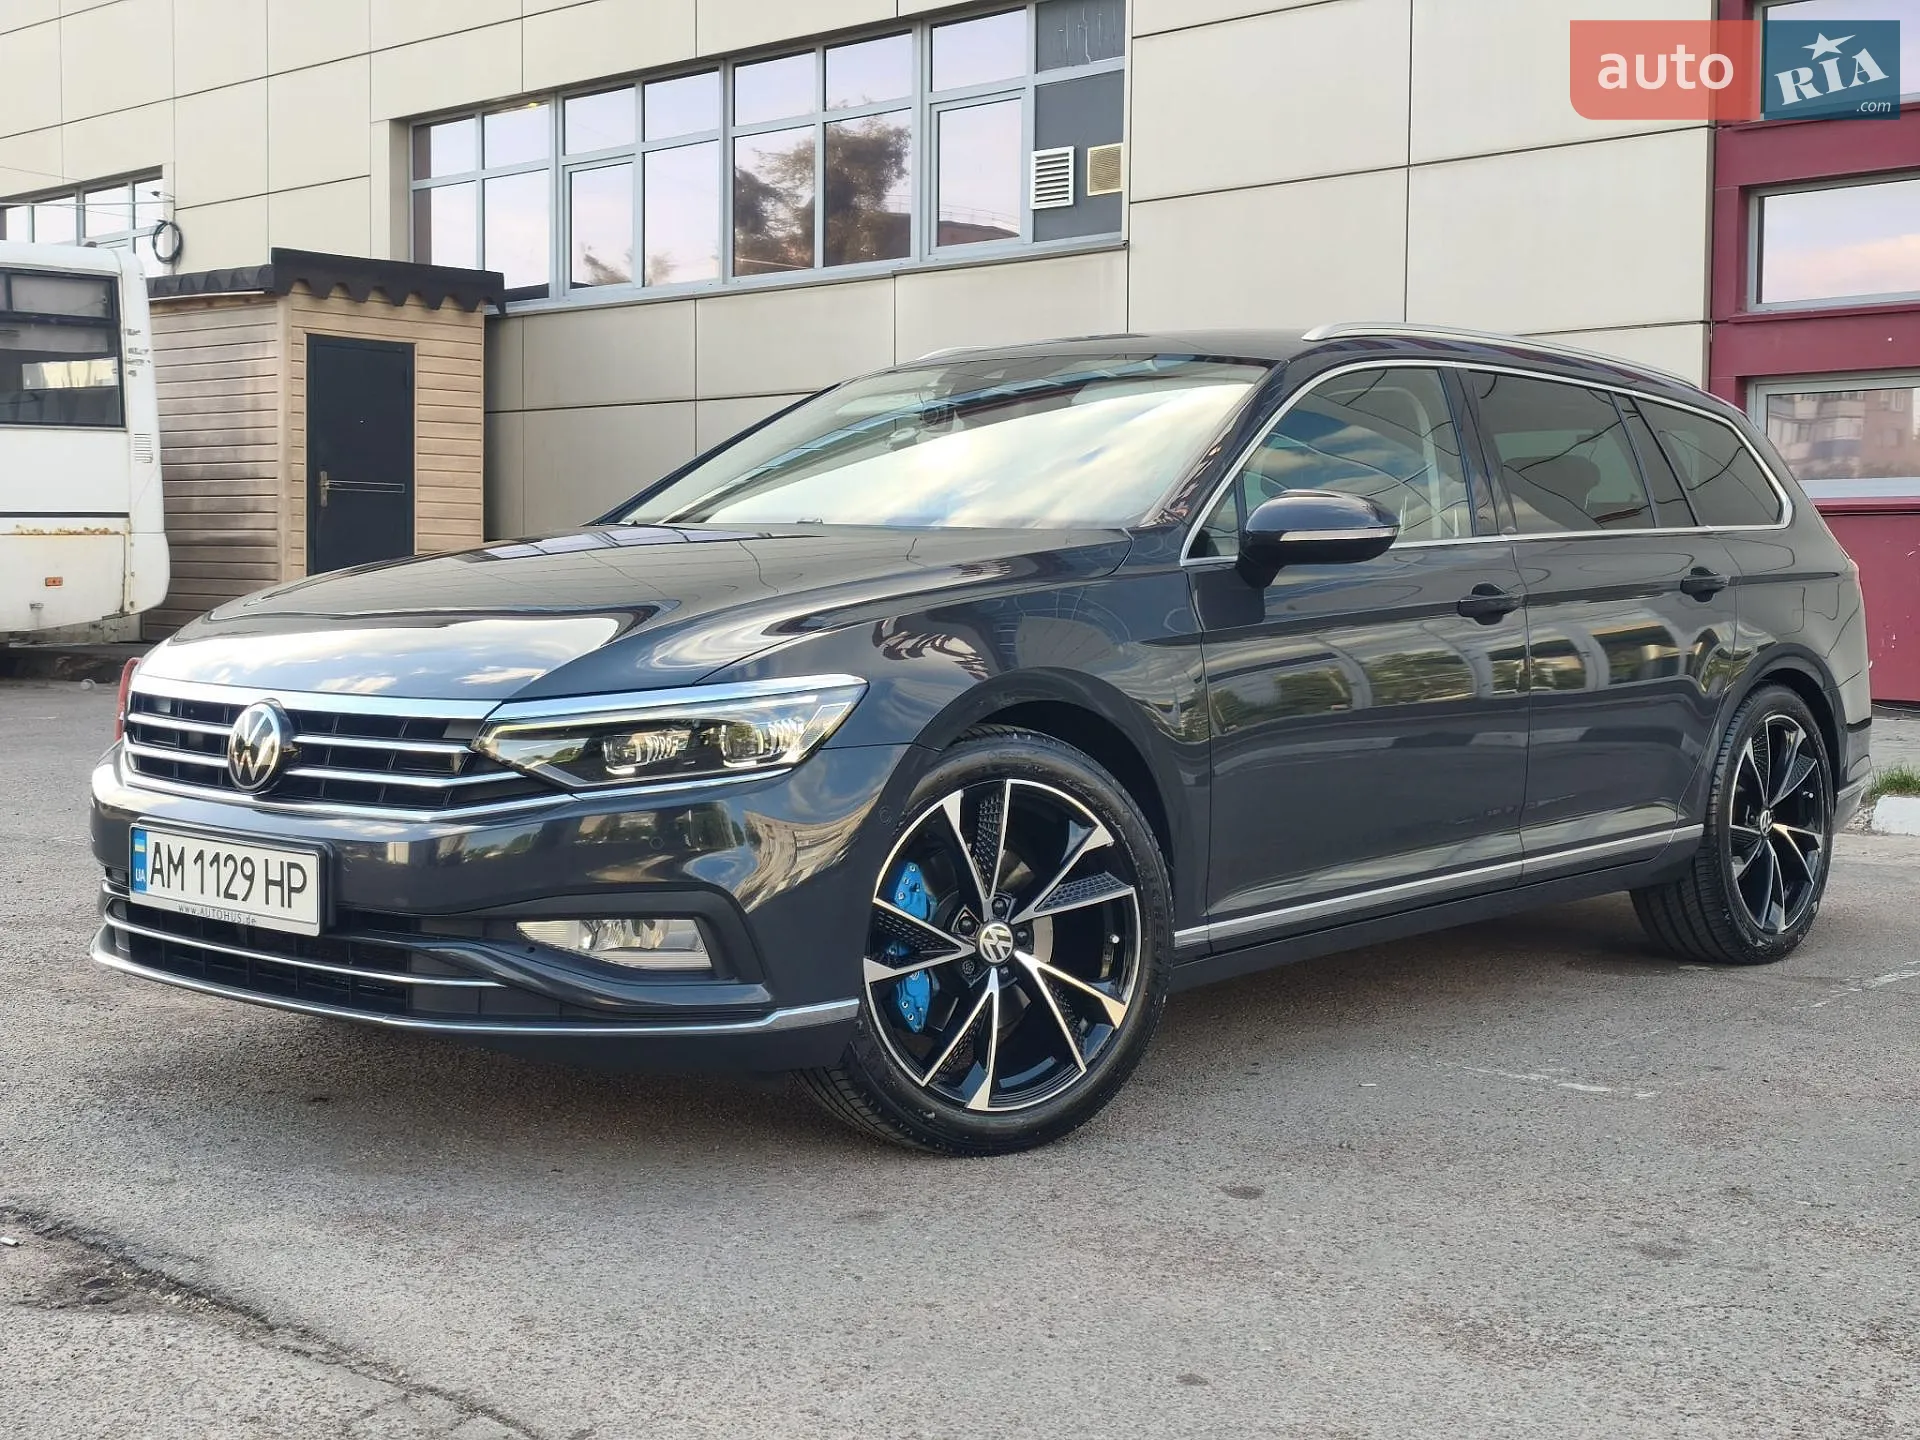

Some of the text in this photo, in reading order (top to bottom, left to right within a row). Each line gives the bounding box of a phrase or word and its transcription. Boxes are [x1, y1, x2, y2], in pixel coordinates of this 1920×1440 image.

[135, 867, 146, 882] UA
[150, 841, 307, 909] AM 1129 HP
